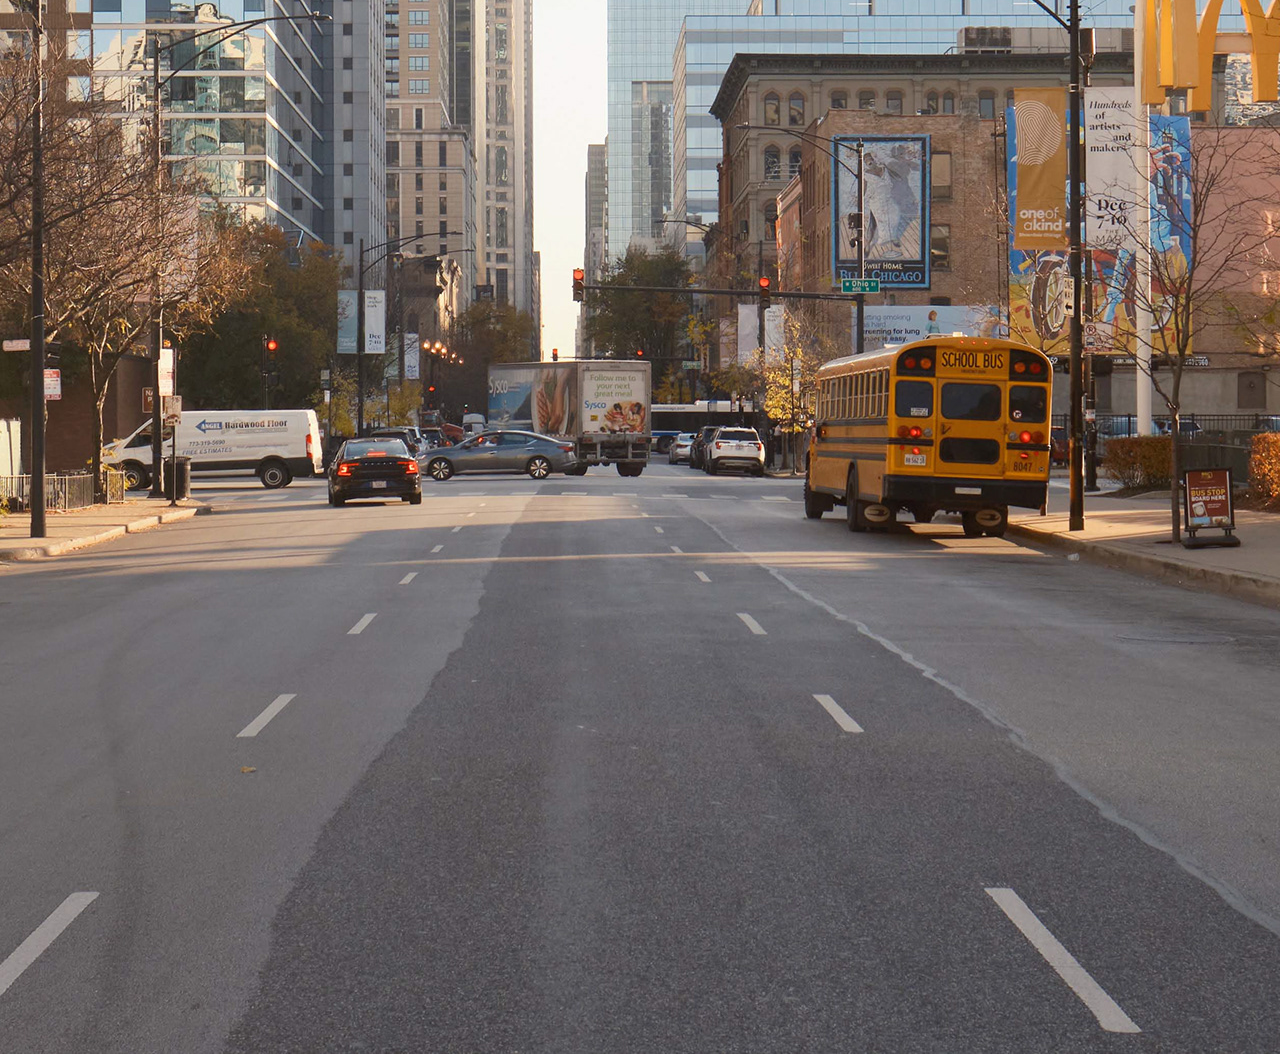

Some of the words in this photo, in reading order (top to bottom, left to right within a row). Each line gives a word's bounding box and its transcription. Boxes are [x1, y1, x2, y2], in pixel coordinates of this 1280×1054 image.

[1090, 100, 1132, 109] Hundreds
[1095, 111, 1106, 119] of
[1090, 122, 1120, 130] artists
[1113, 133, 1131, 141] and
[1098, 199, 1126, 211] Dec
[883, 262, 903, 270] HOME
[872, 270, 922, 282] CHICAGO
[942, 352, 980, 368] SCHOOL
[983, 353, 1004, 369] BUS
[590, 374, 614, 382] Follow
[628, 374, 636, 382] to
[489, 376, 508, 397] Sysco
[584, 400, 606, 410] Sysco
[225, 421, 265, 429] Hardwood
[1013, 462, 1032, 472] 8047
